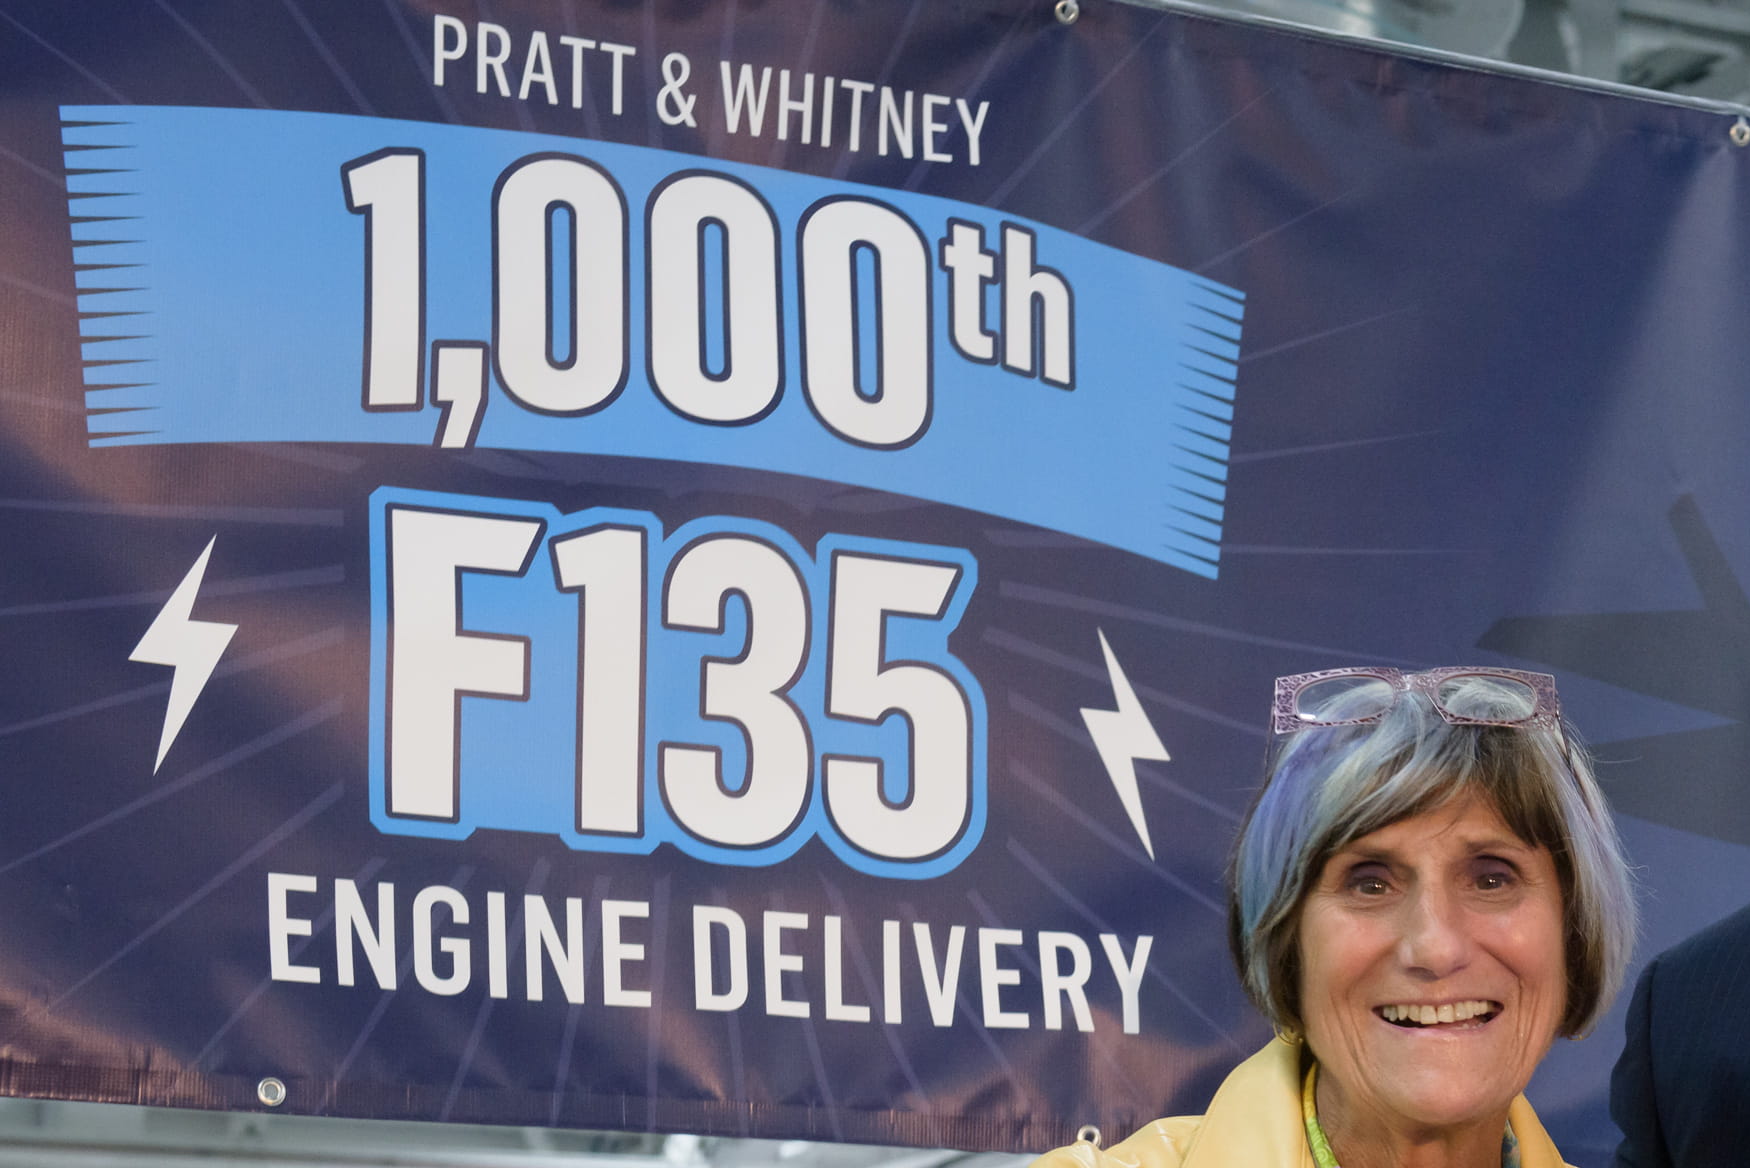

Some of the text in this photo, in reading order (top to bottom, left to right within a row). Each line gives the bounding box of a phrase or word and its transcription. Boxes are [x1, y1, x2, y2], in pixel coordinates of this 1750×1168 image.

[433, 14, 990, 169] PRATT & WHITNEY
[343, 147, 1074, 451] 1,000th
[388, 505, 970, 862] F135
[267, 871, 1155, 1035] ENGINE DELIVERY
